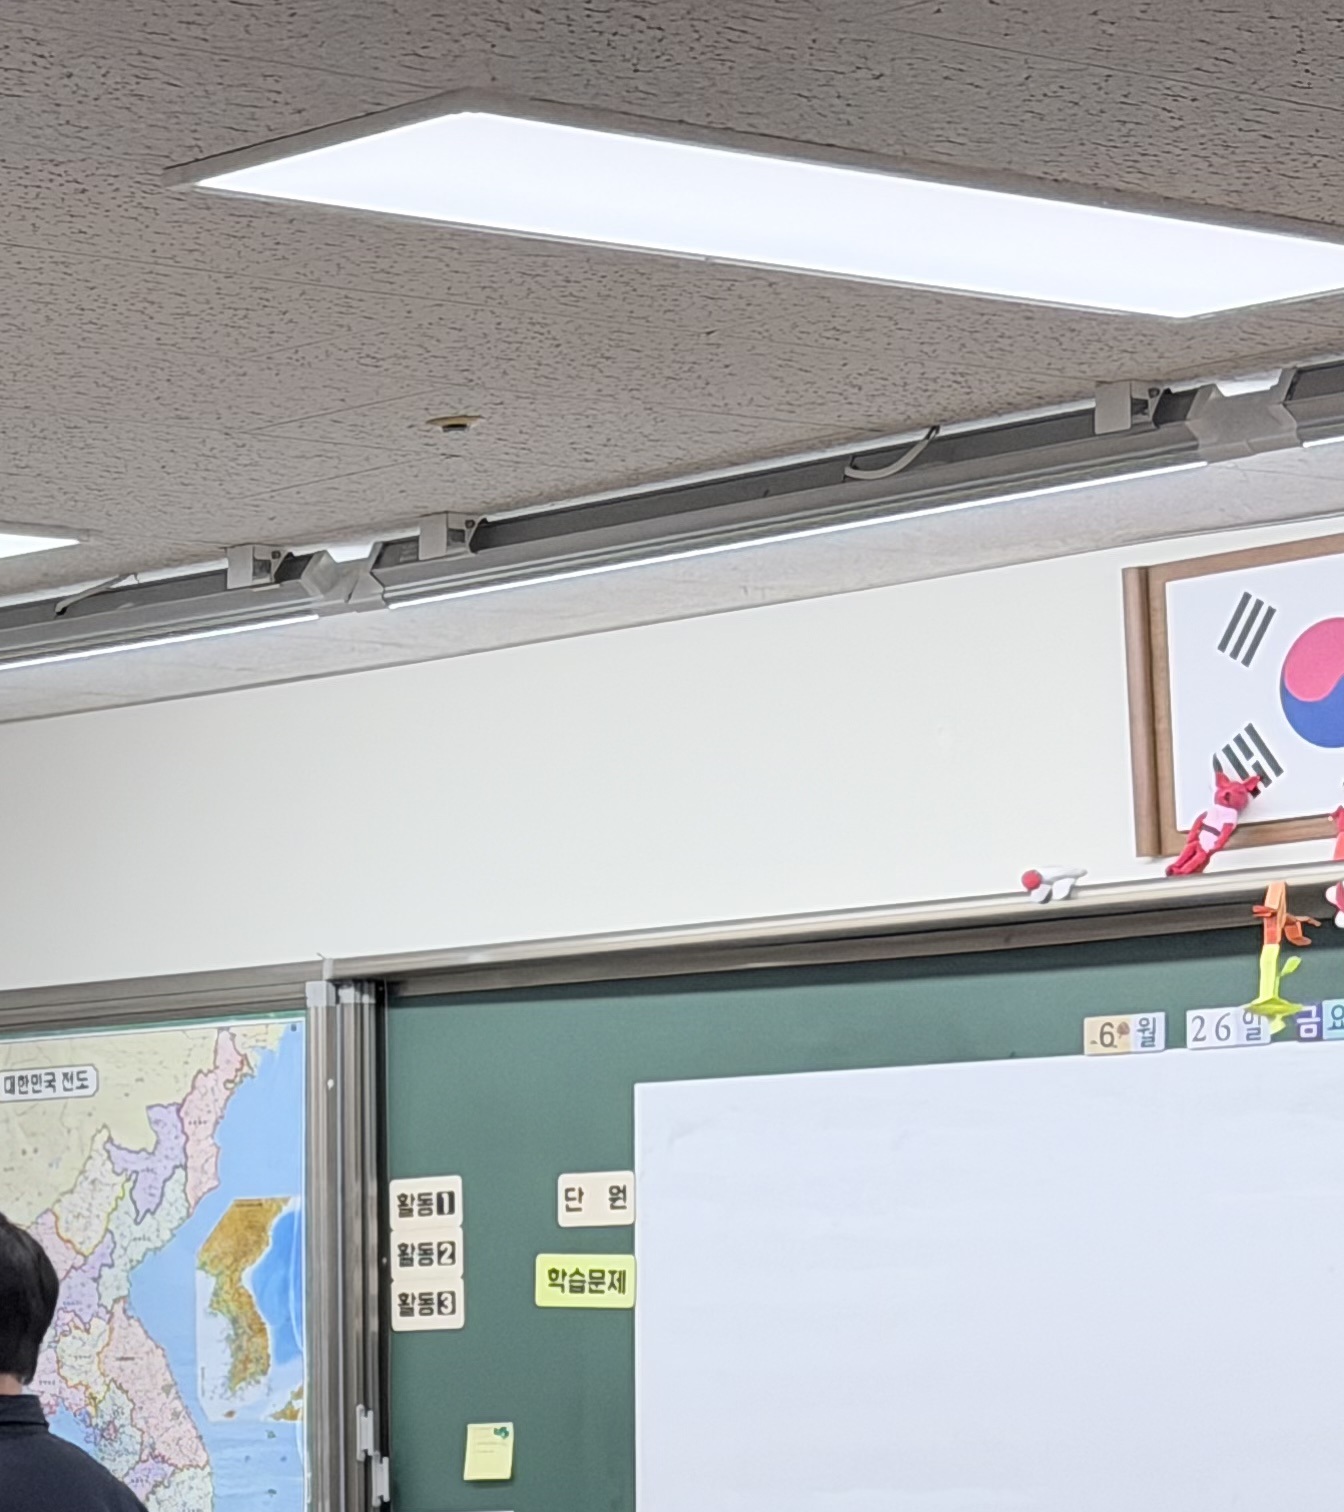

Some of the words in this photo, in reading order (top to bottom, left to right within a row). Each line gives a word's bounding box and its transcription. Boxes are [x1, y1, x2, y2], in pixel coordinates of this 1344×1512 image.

[3, 1071, 57, 1096] 대한민국
[62, 1070, 90, 1092] 전도
[397, 1190, 456, 1219] 활동1
[397, 1240, 456, 1268] 활동2
[547, 1267, 627, 1295] 학습문제
[397, 1290, 456, 1318] 활동3
